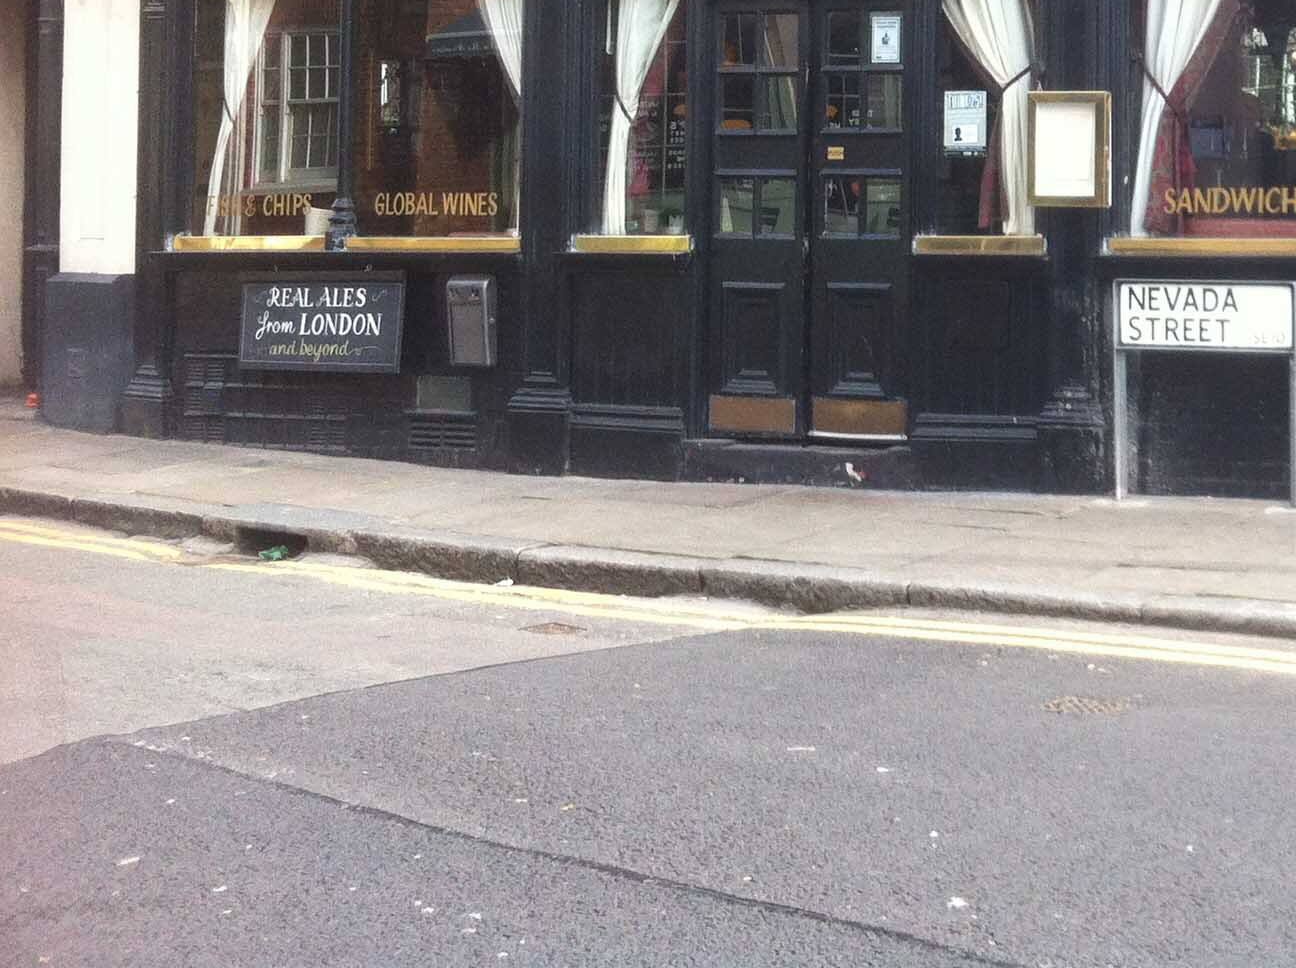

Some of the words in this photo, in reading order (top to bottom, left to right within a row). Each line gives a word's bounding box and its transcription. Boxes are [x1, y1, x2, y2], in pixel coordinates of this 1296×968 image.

[245, 194, 257, 217] &
[262, 193, 313, 217] CHIPS
[374, 191, 438, 217] GLOBAL
[442, 191, 498, 217] WINES
[266, 286, 313, 308] REAL
[316, 286, 367, 308] ALES
[1128, 286, 1240, 314] NEVADA
[255, 310, 296, 340] from
[299, 312, 383, 336] LONDON
[1128, 317, 1232, 344] STREET
[269, 339, 297, 356] and
[299, 338, 351, 362] beyond
